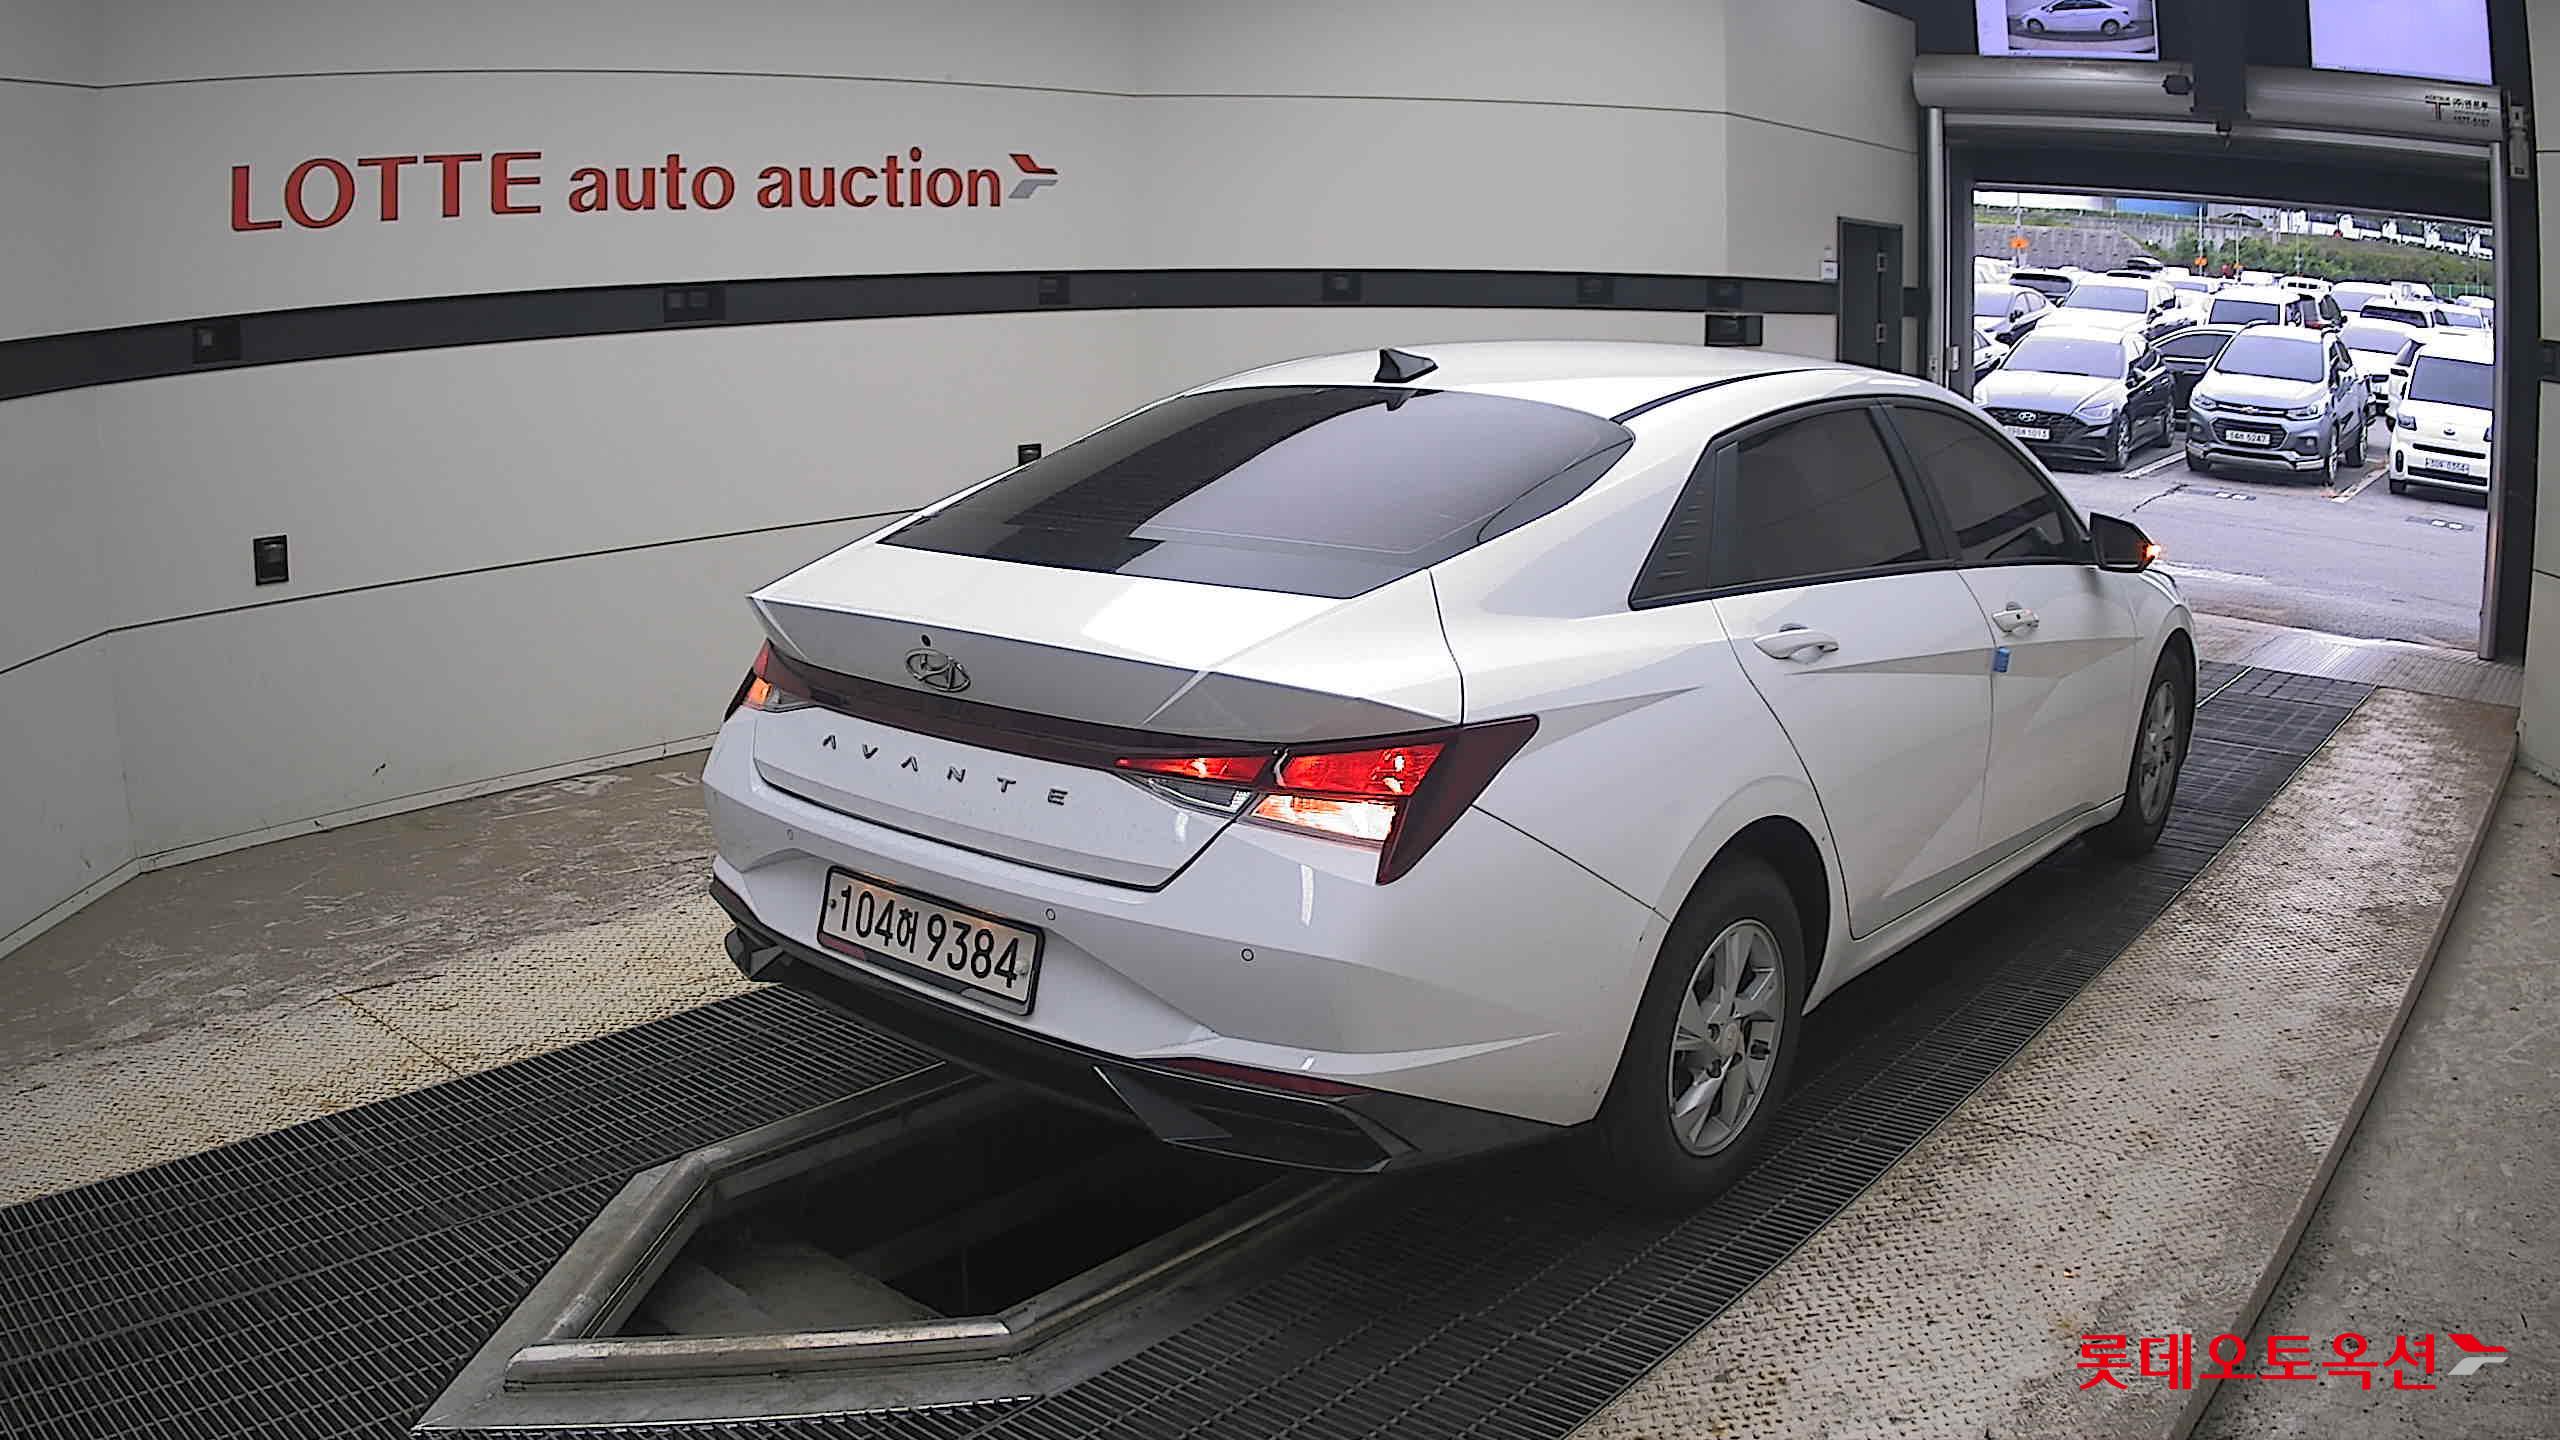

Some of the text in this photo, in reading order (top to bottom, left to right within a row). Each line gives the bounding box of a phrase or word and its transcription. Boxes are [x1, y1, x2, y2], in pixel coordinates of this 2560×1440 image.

[231, 146, 1001, 232] LOTTE auto auction
[822, 734, 1069, 806] AVANTE
[926, 912, 1020, 989] 9384
